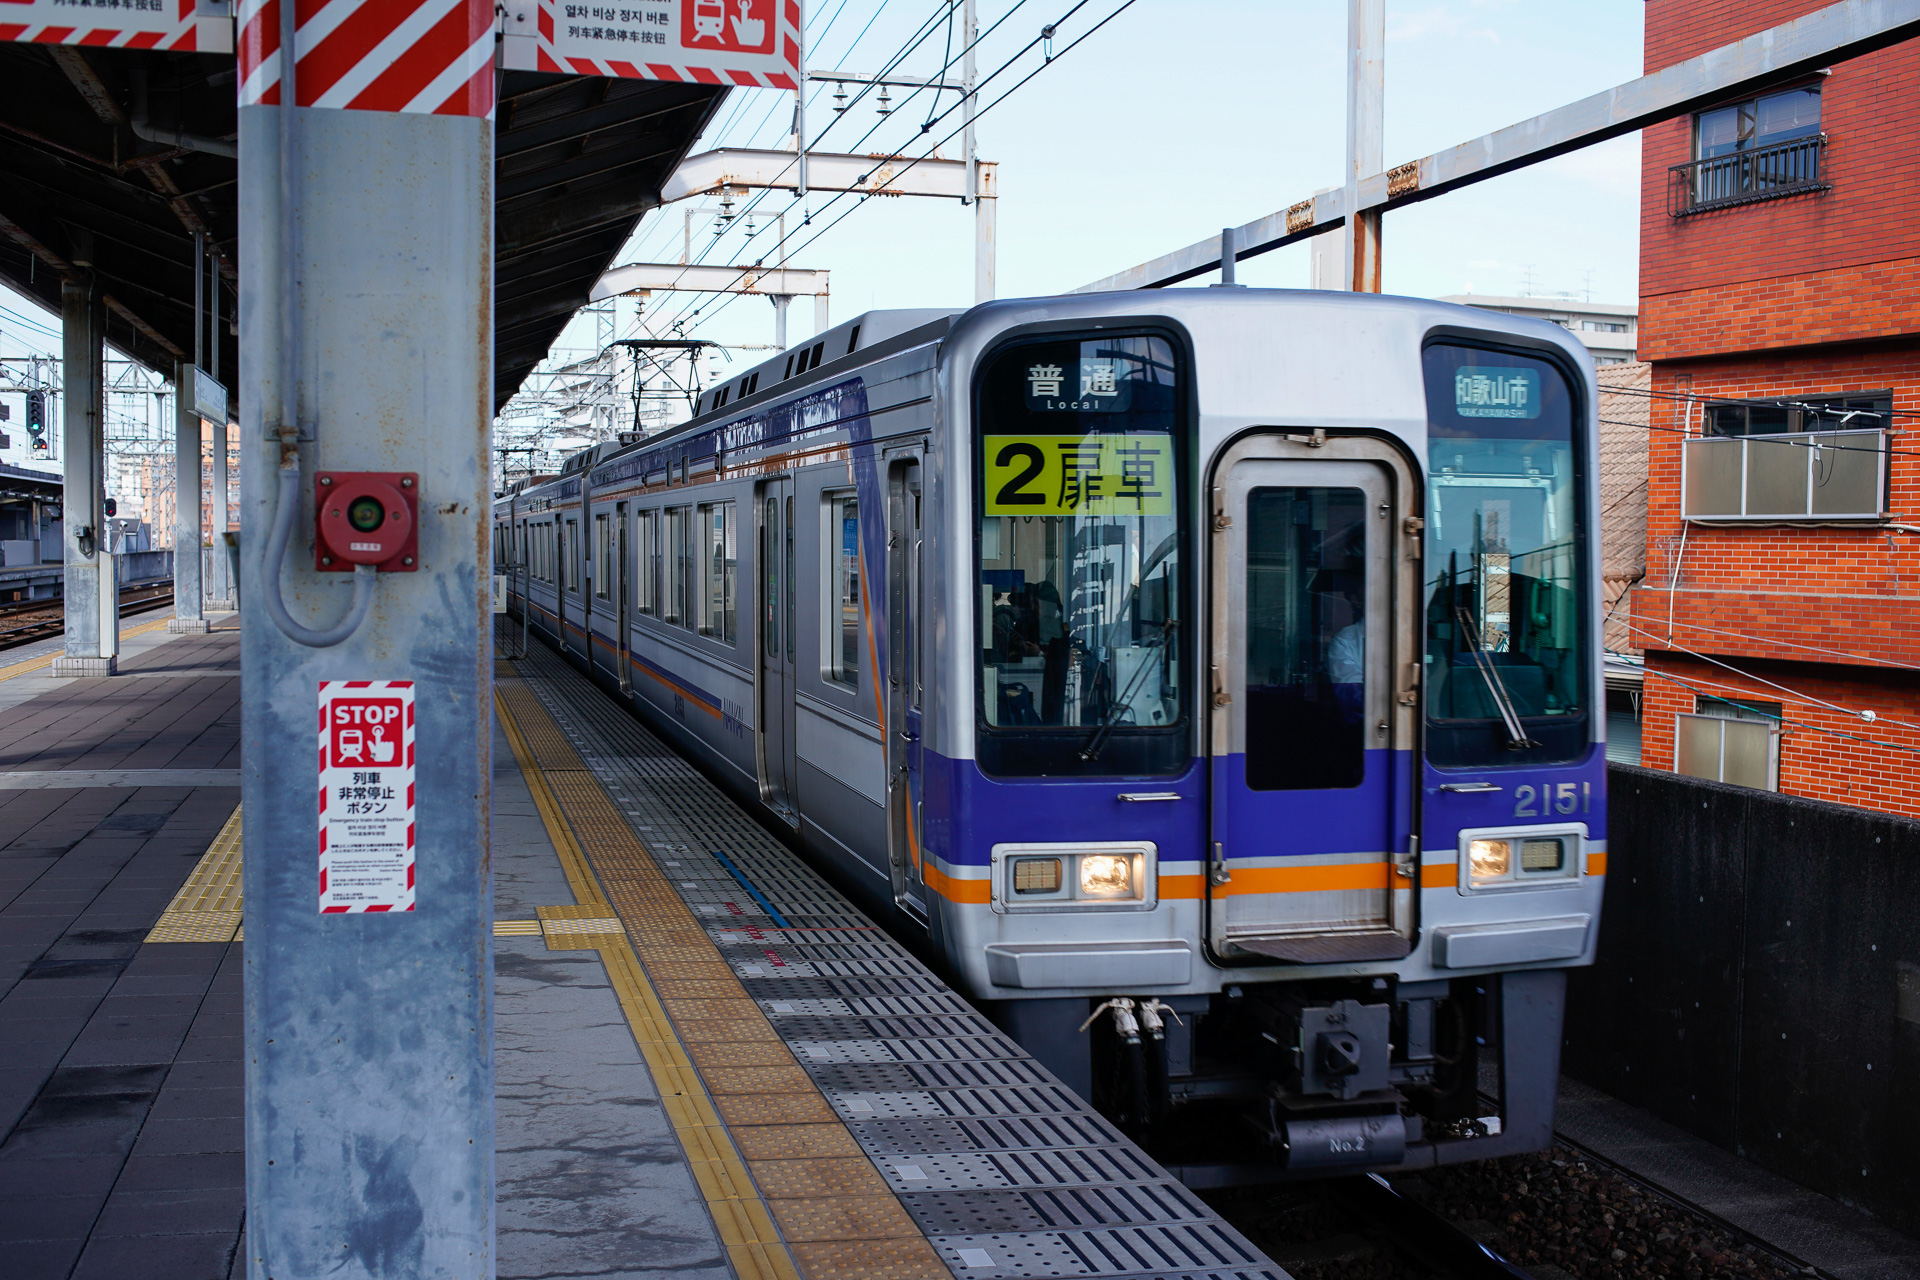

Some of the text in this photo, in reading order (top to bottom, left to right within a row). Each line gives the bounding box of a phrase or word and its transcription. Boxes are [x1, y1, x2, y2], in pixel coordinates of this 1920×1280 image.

[565, 4, 670, 25] 열차 비상 정지 버튼
[568, 25, 666, 44] 列车紧急停车按钮
[1027, 364, 1119, 397] 普通
[1455, 375, 1529, 407] 和歌山市
[1047, 400, 1099, 410] Local
[995, 441, 1162, 511] 2扉車
[335, 705, 399, 724] STOP
[352, 772, 381, 785] 列車
[339, 786, 395, 801] 非常停止
[1514, 781, 1591, 818] 2151
[347, 801, 387, 815] ボタン
[1330, 1136, 1365, 1153] No.2
